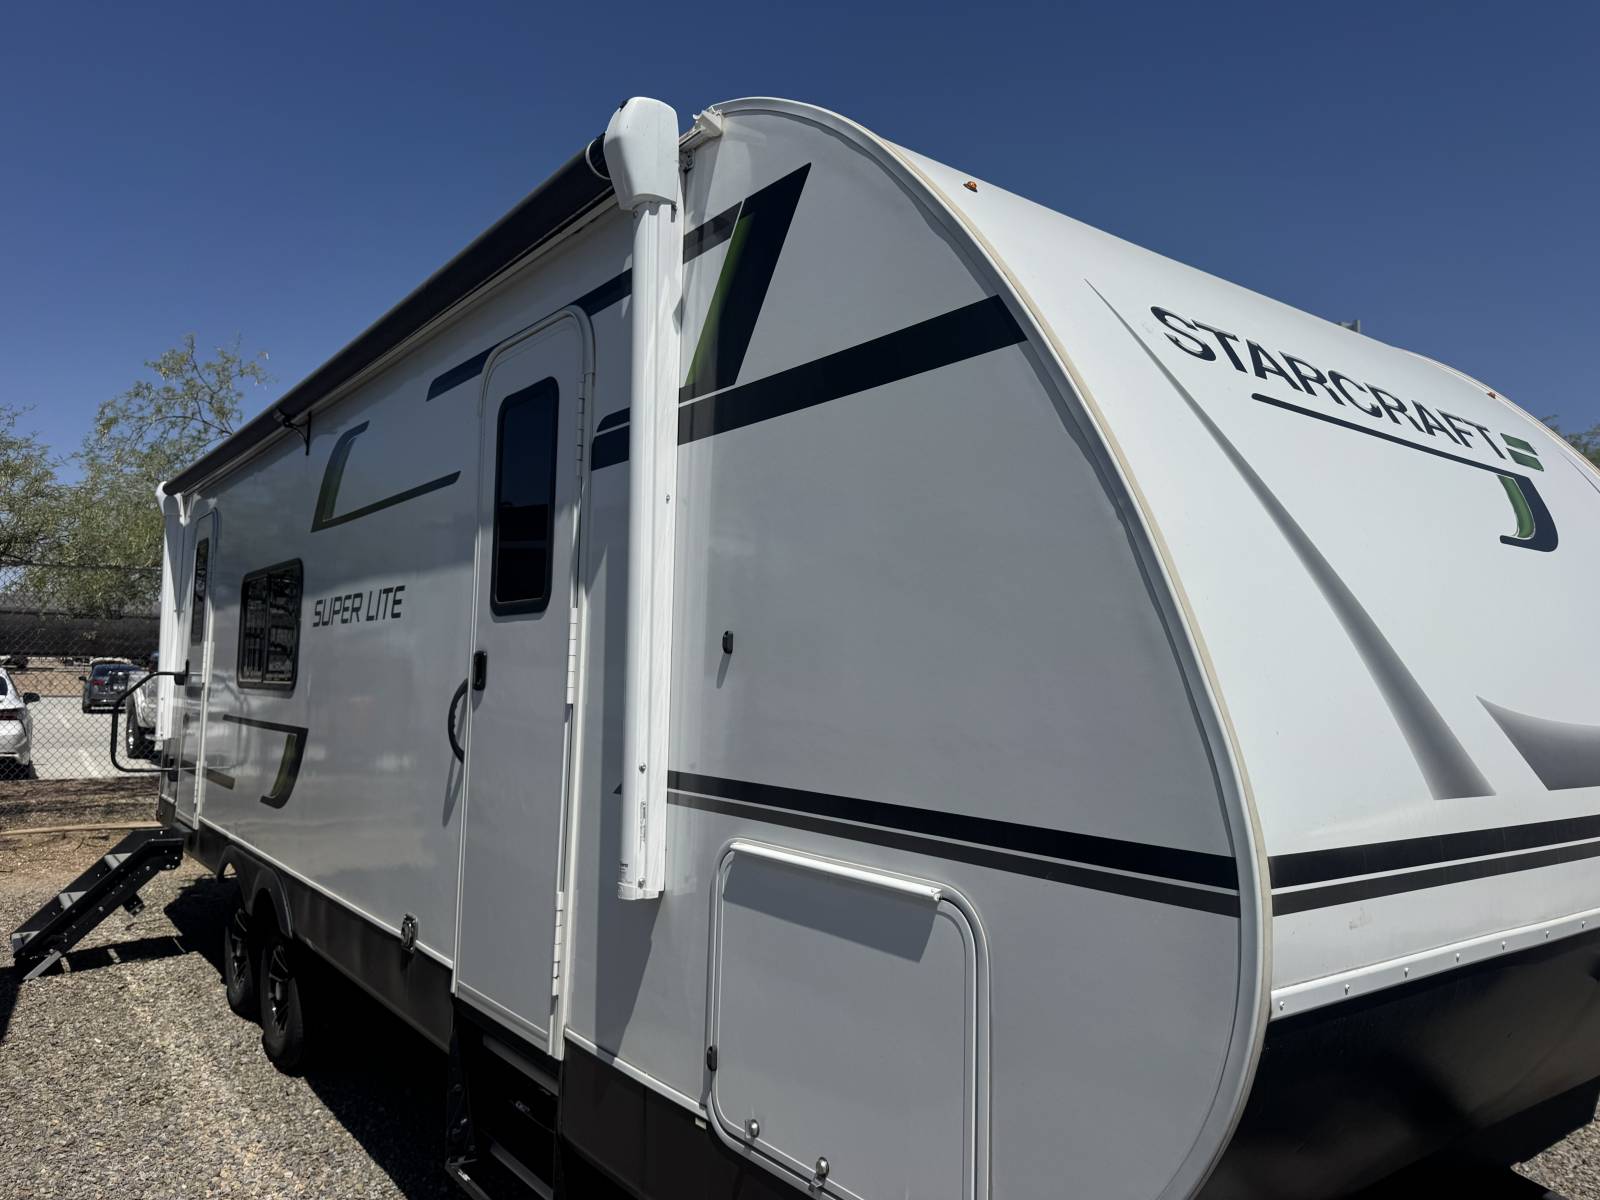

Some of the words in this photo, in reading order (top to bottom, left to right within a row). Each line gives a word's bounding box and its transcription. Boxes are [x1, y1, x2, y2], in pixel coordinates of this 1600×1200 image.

[1150, 306, 1507, 460] STARCRAFT
[312, 592, 363, 627] SUPER
[365, 585, 405, 621] LITE
